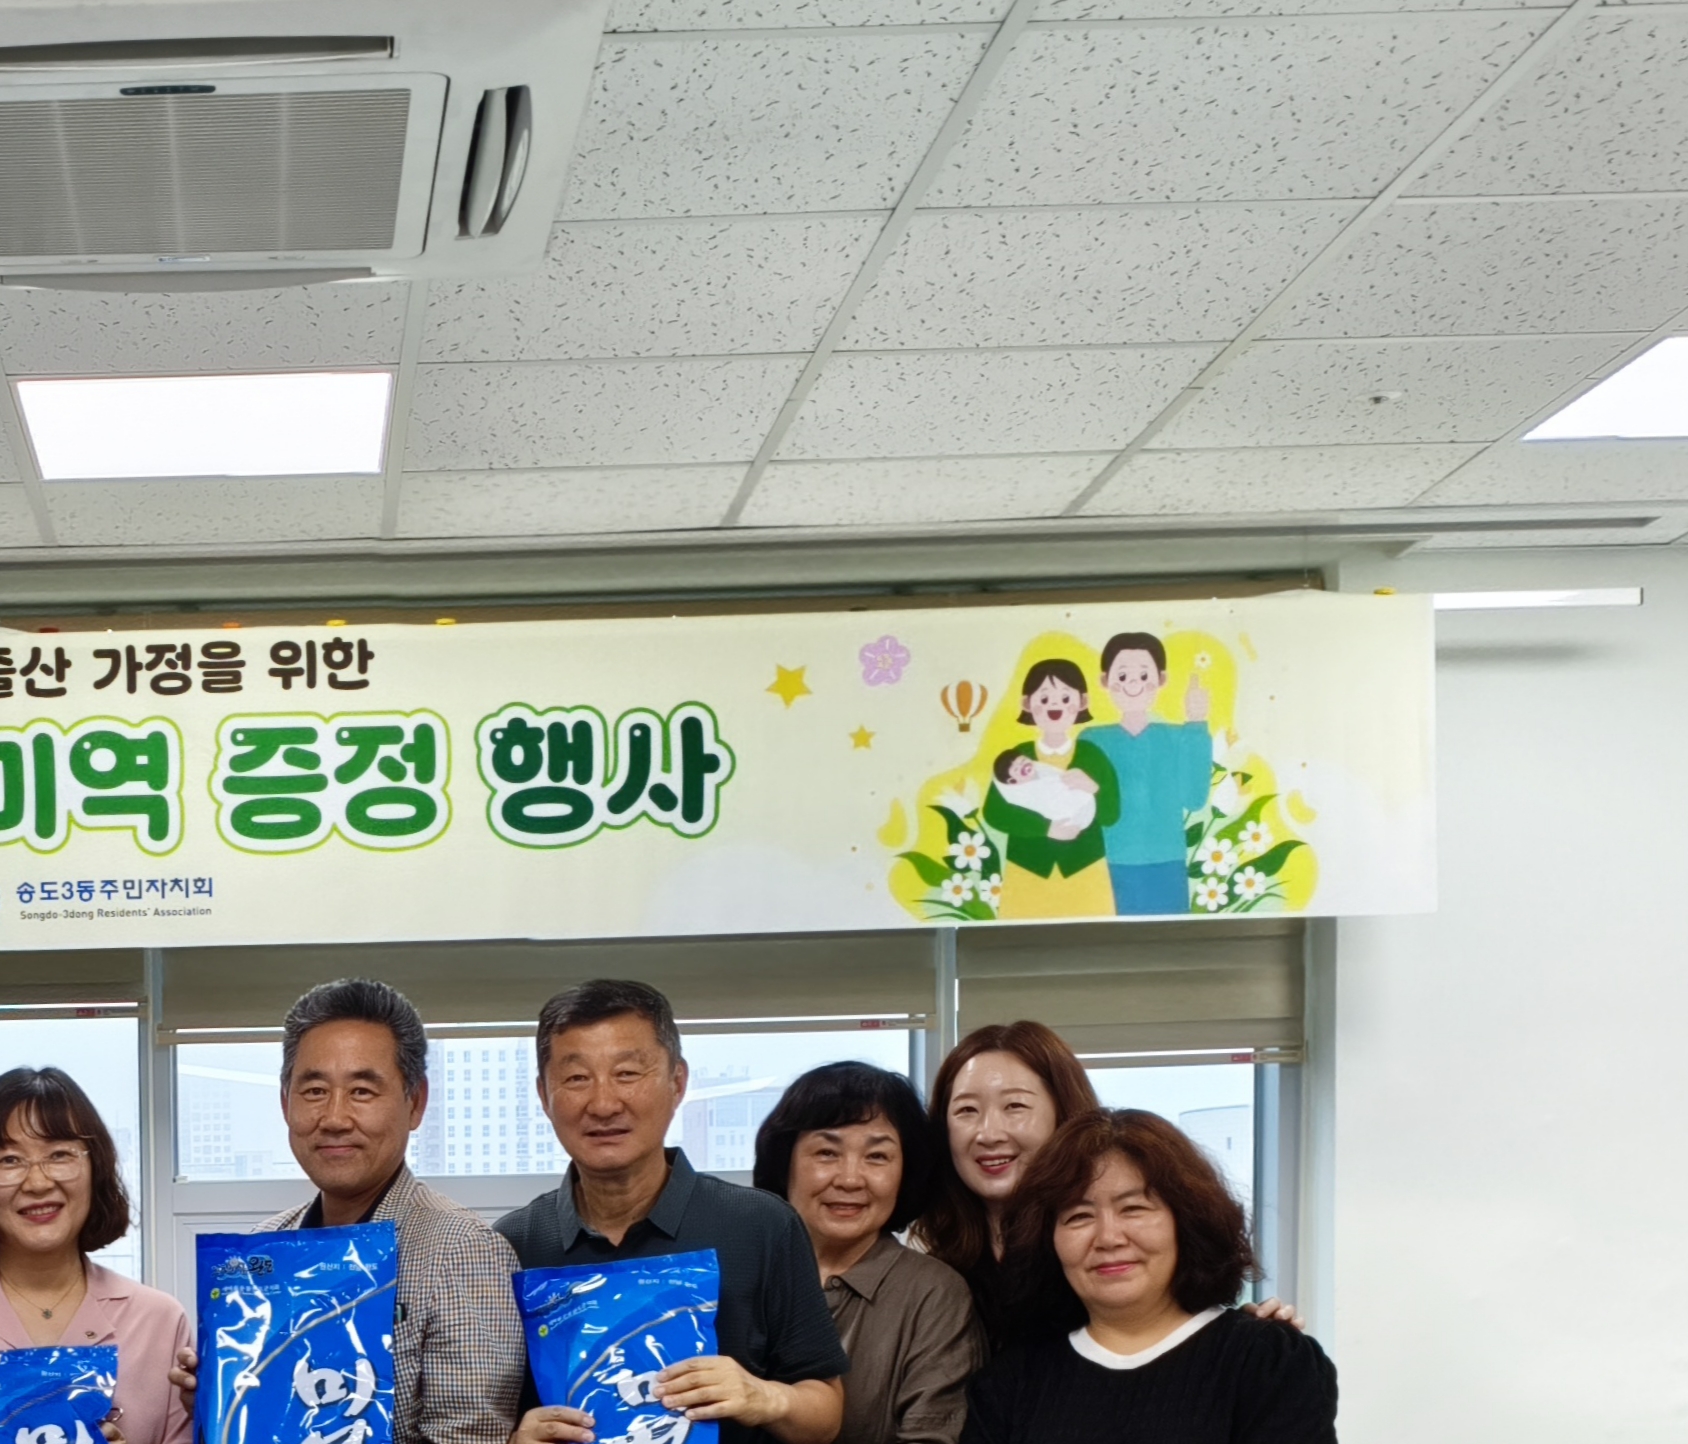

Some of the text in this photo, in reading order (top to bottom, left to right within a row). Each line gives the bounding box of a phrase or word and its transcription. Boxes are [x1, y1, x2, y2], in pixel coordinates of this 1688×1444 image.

[93, 641, 246, 695] 가정을
[268, 637, 374, 690] 위한
[226, 722, 449, 839] 증정
[489, 714, 723, 834] 행사
[16, 877, 212, 904] 송도3동주민자치회
[20, 909, 94, 920] Songdo-3dong
[154, 907, 212, 917] Association
